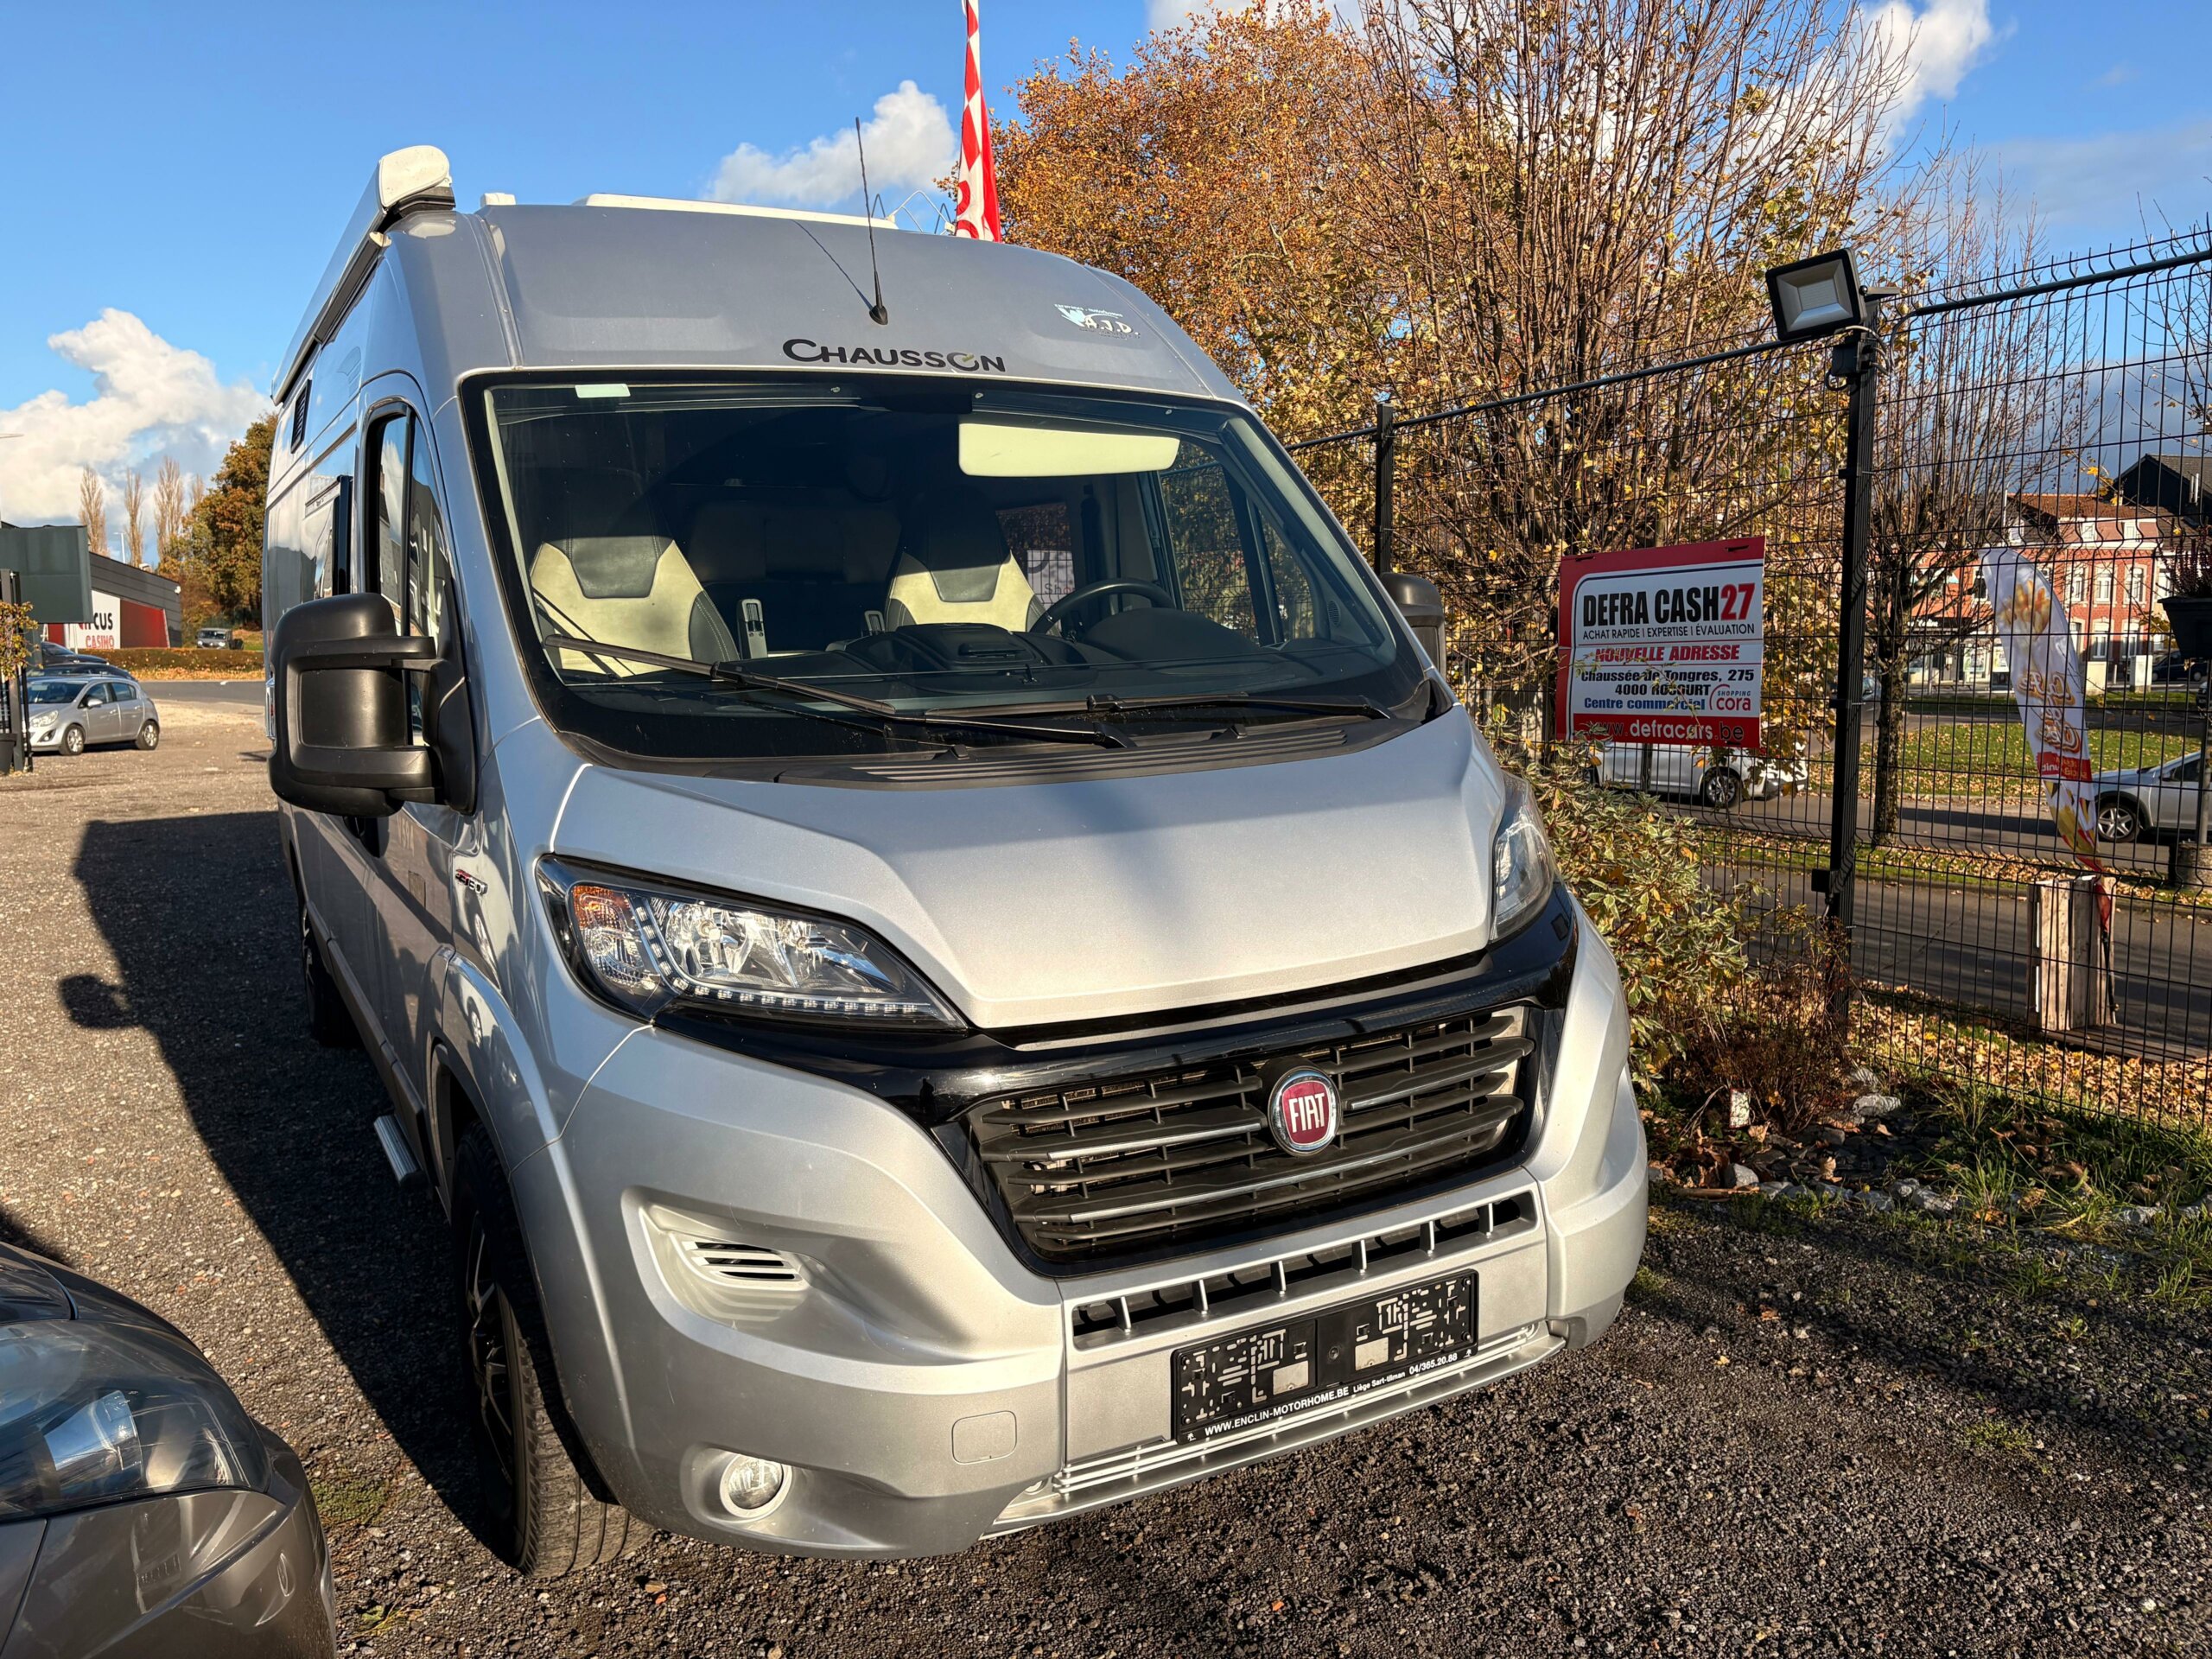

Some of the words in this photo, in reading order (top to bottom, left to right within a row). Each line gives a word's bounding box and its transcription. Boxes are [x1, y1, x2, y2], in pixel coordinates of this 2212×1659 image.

[782, 338, 1006, 372] CHAUSSON
[1583, 591, 1649, 627] DEFRA
[1583, 630, 1610, 640] ACHAT
[1611, 628, 1640, 639] RAPIDE
[1647, 626, 1688, 638] EXPERTISE
[1695, 622, 1755, 636] ÉVALUATION
[1595, 646, 1664, 662] NOUVELLE
[1669, 645, 1740, 661] ADRESSE
[1581, 670, 1639, 682] Chaussée
[1643, 670, 1660, 682] de
[1665, 670, 1722, 683] Tongres,
[1727, 669, 1754, 681] 275
[1615, 684, 1647, 696] 4000
[1585, 697, 1623, 709] Centre
[1716, 697, 1751, 711] cora
[1288, 1092, 1325, 1134] FIAT
[1205, 1386, 1350, 1436] WWW.ENCLIN-MOTORHOME.BE
